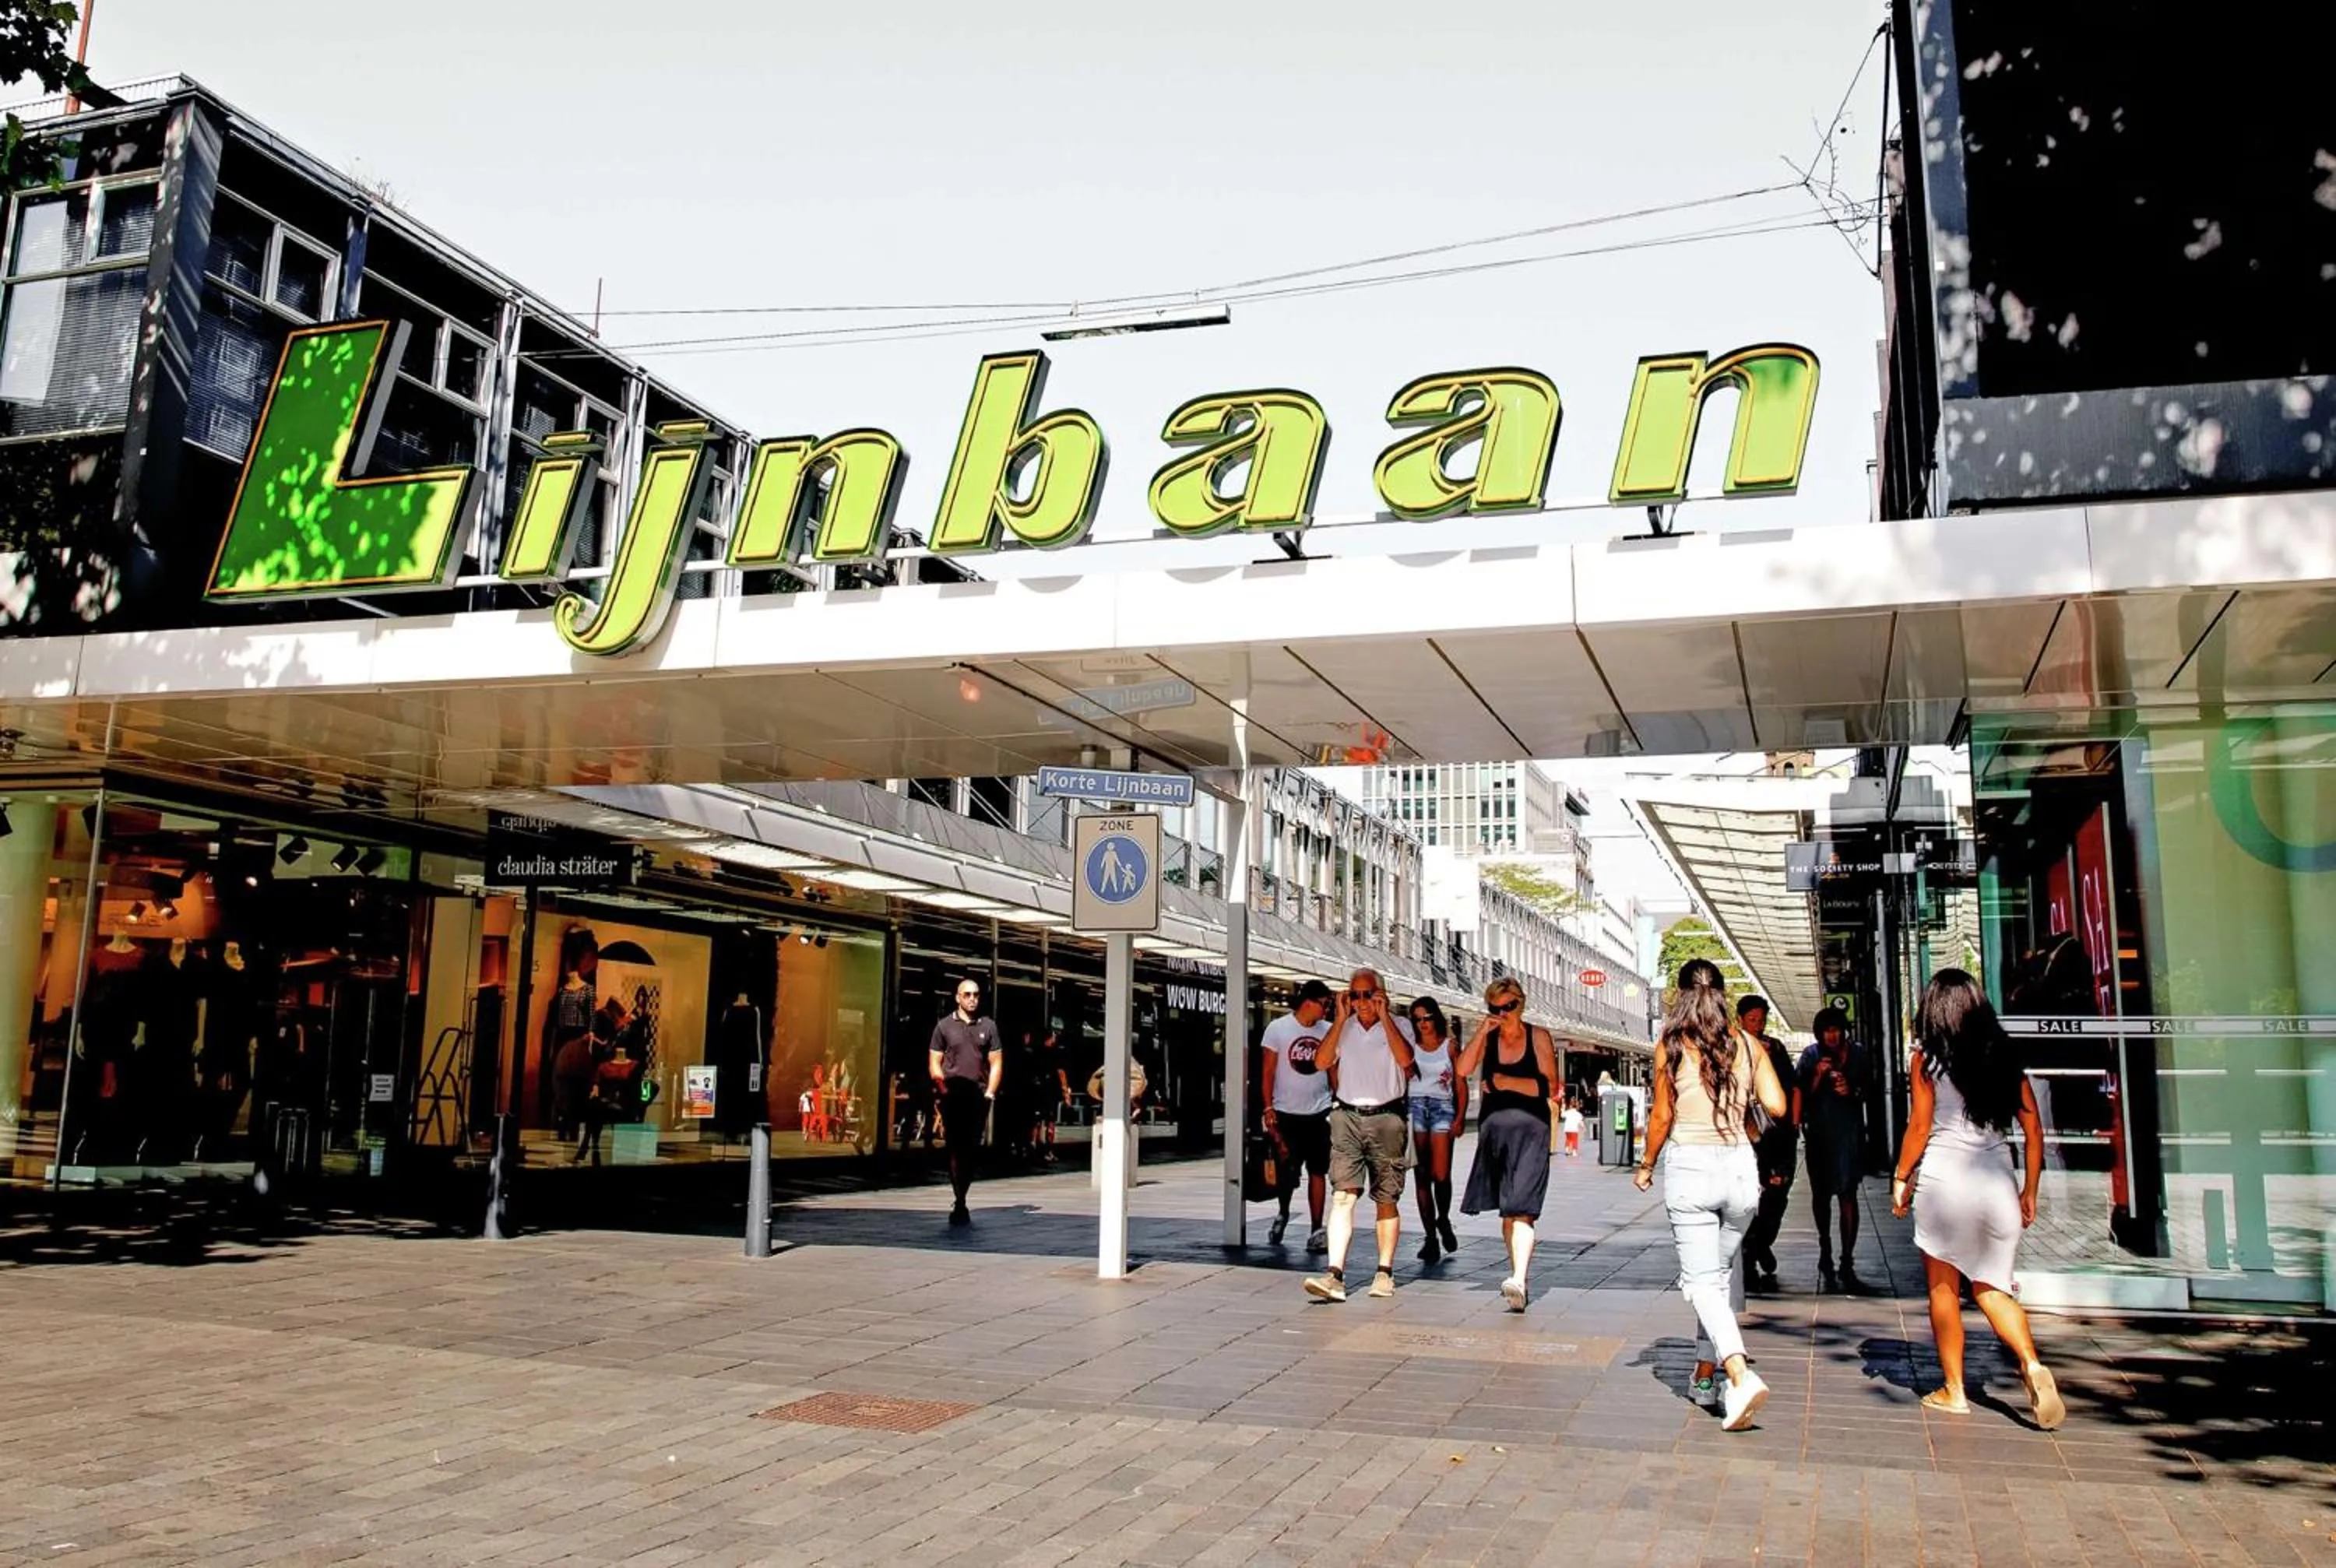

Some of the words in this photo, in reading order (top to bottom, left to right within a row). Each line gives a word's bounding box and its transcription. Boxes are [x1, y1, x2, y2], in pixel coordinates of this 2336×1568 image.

[204, 319, 1822, 656] Lijnbaan
[1045, 772, 1096, 790] Korte
[1104, 775, 1184, 797] Lijnbaan
[1099, 820, 1135, 831] ZONE
[497, 853, 556, 876] claudia
[558, 856, 619, 876] sträter
[1813, 863, 1855, 874] SOCIETY
[1856, 862, 1881, 873] SHOP
[1166, 983, 1198, 1010] WOW
[1198, 989, 1226, 1014] BURG
[2039, 1021, 2082, 1033] SALE
[2151, 1021, 2194, 1033] SALE
[2264, 1020, 2308, 1033] SALE
